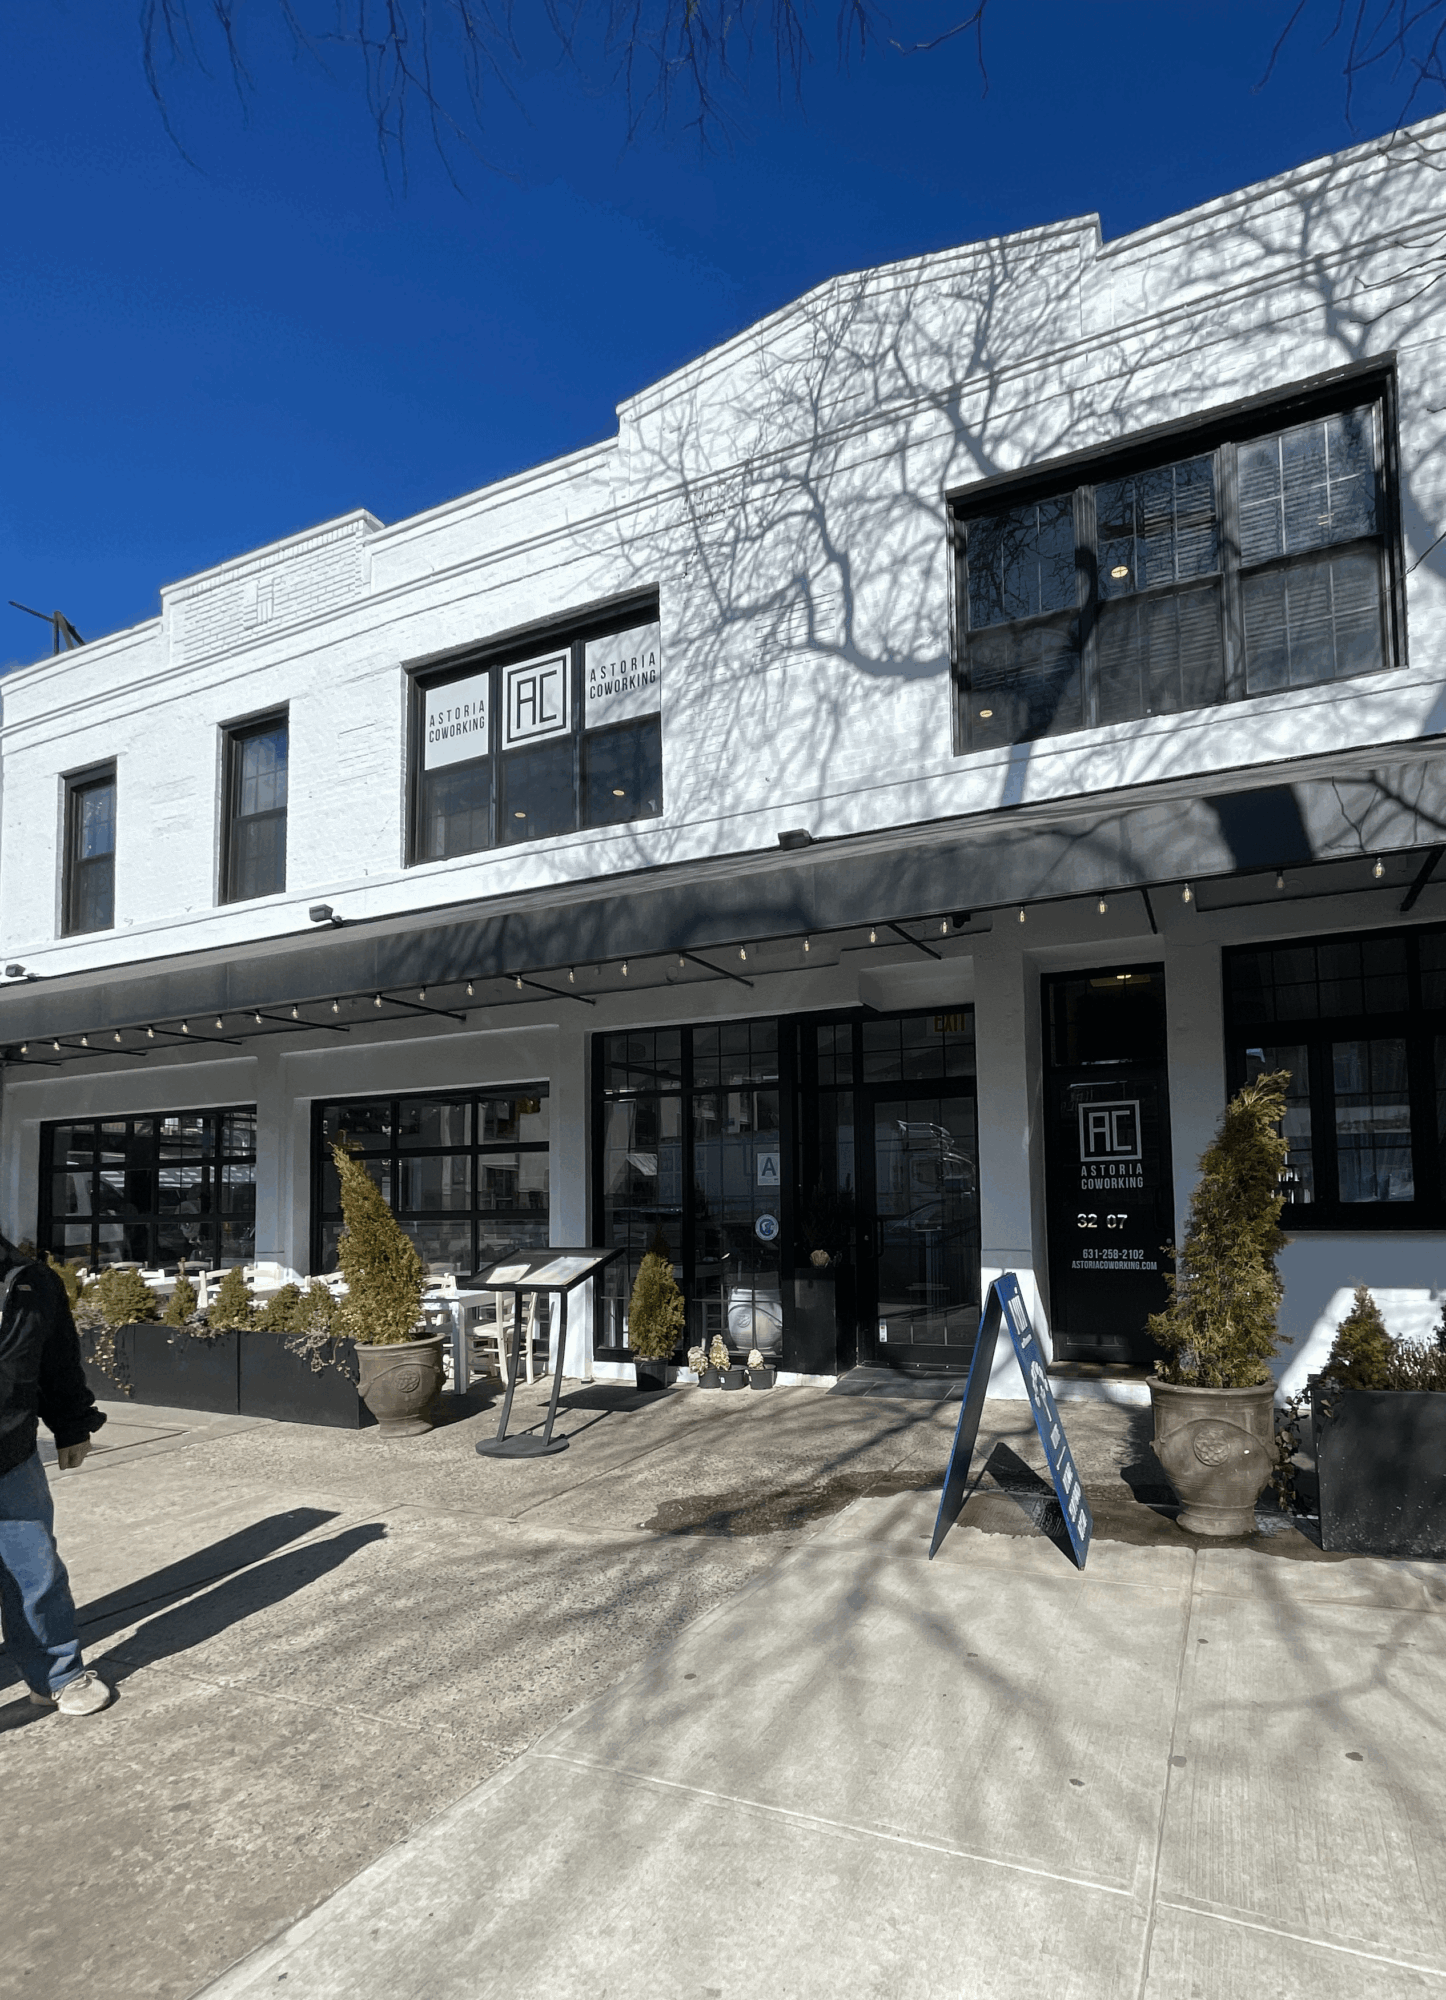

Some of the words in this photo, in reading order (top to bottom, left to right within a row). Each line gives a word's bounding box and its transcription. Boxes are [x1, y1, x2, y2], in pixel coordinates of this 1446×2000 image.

[590, 652, 655, 682] ASTORIA
[589, 669, 656, 699] COWORKING
[429, 700, 485, 727] ASTORIA
[429, 716, 485, 743] COWORKING
[1088, 1110, 1132, 1152] AC
[761, 1157, 776, 1176] A
[1081, 1163, 1143, 1177] ASTORIA
[1081, 1177, 1144, 1190] COWORKING
[1077, 1213, 1098, 1228] 32
[1106, 1214, 1128, 1229] 07
[1082, 1249, 1144, 1260] 631-258-2102
[1071, 1260, 1158, 1270] ASTORIACOWORKING.COM
